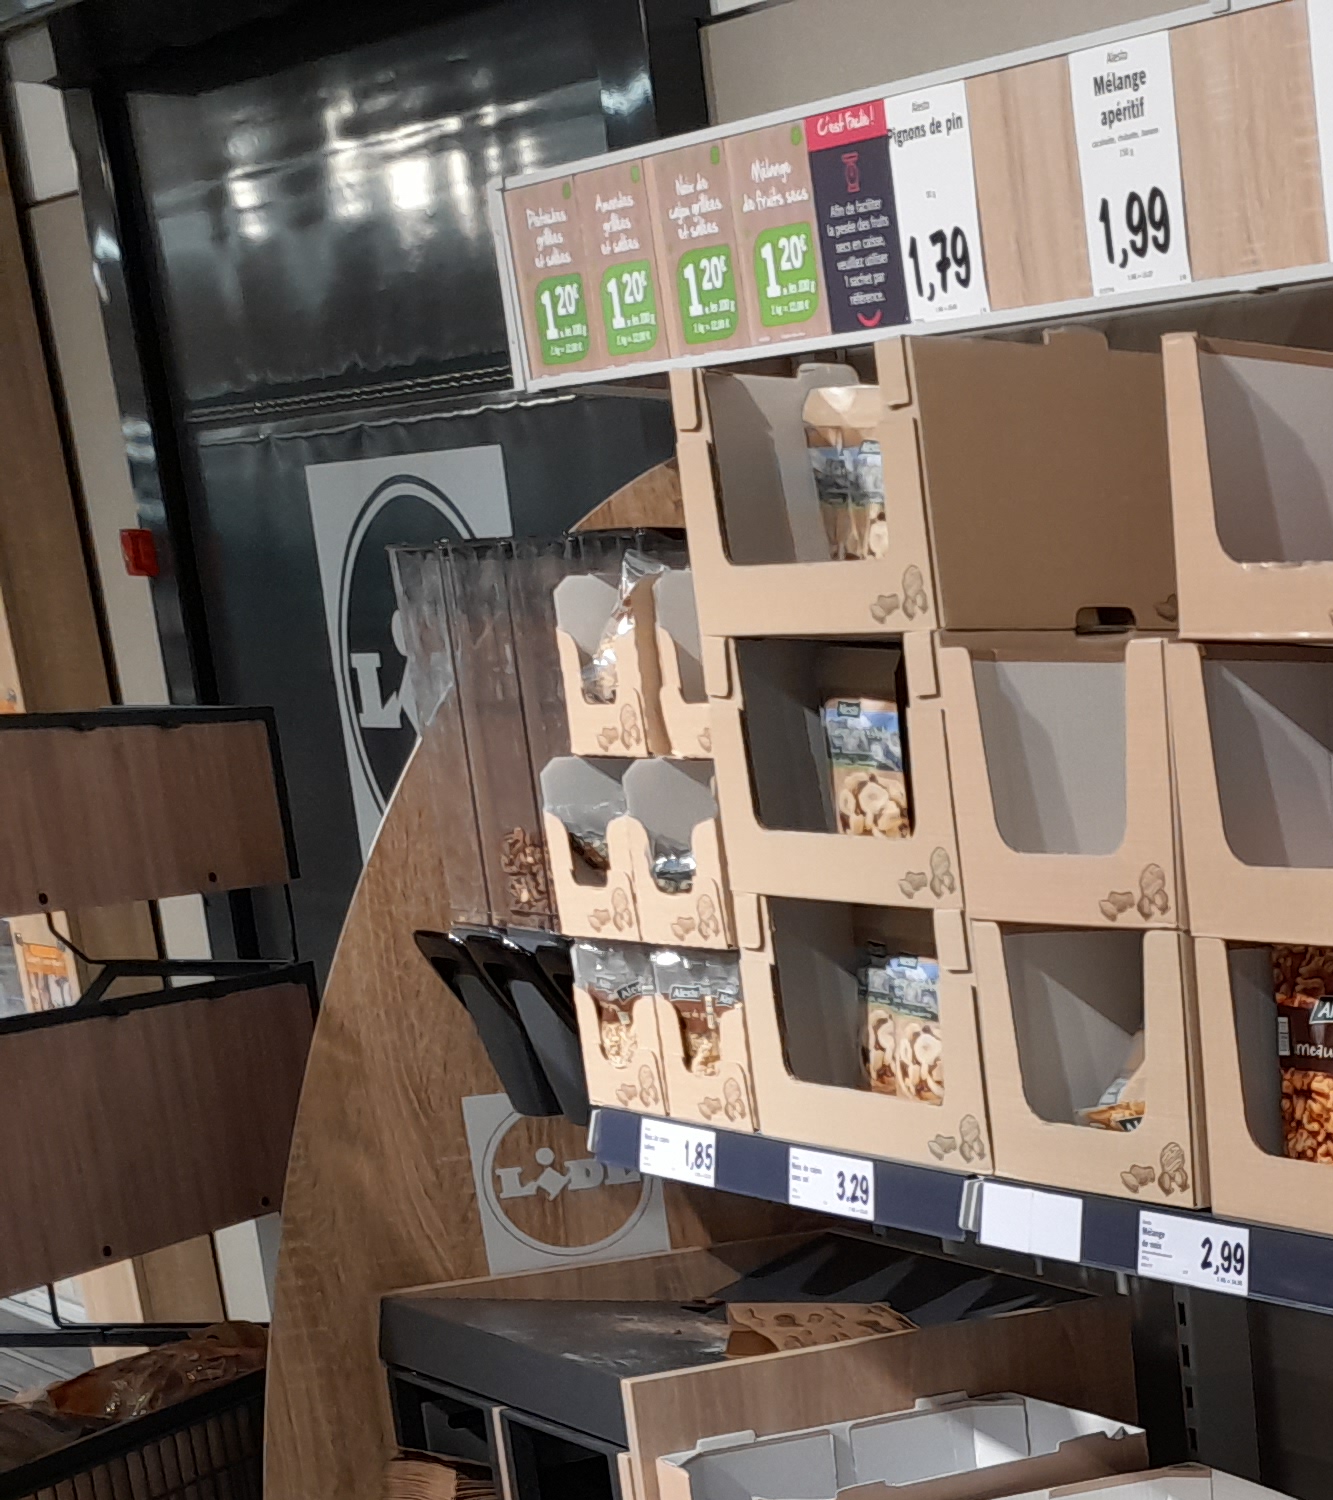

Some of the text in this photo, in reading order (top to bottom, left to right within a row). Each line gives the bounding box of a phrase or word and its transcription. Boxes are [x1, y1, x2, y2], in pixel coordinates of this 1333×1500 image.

[1093, 70, 1146, 96] Mélange
[930, 117, 942, 135] de
[946, 112, 963, 135] pin
[1101, 97, 1144, 129] apéritif
[1099, 186, 1171, 269] 1,99
[909, 226, 970, 302] 1,79
[685, 1140, 713, 1171] 1,85
